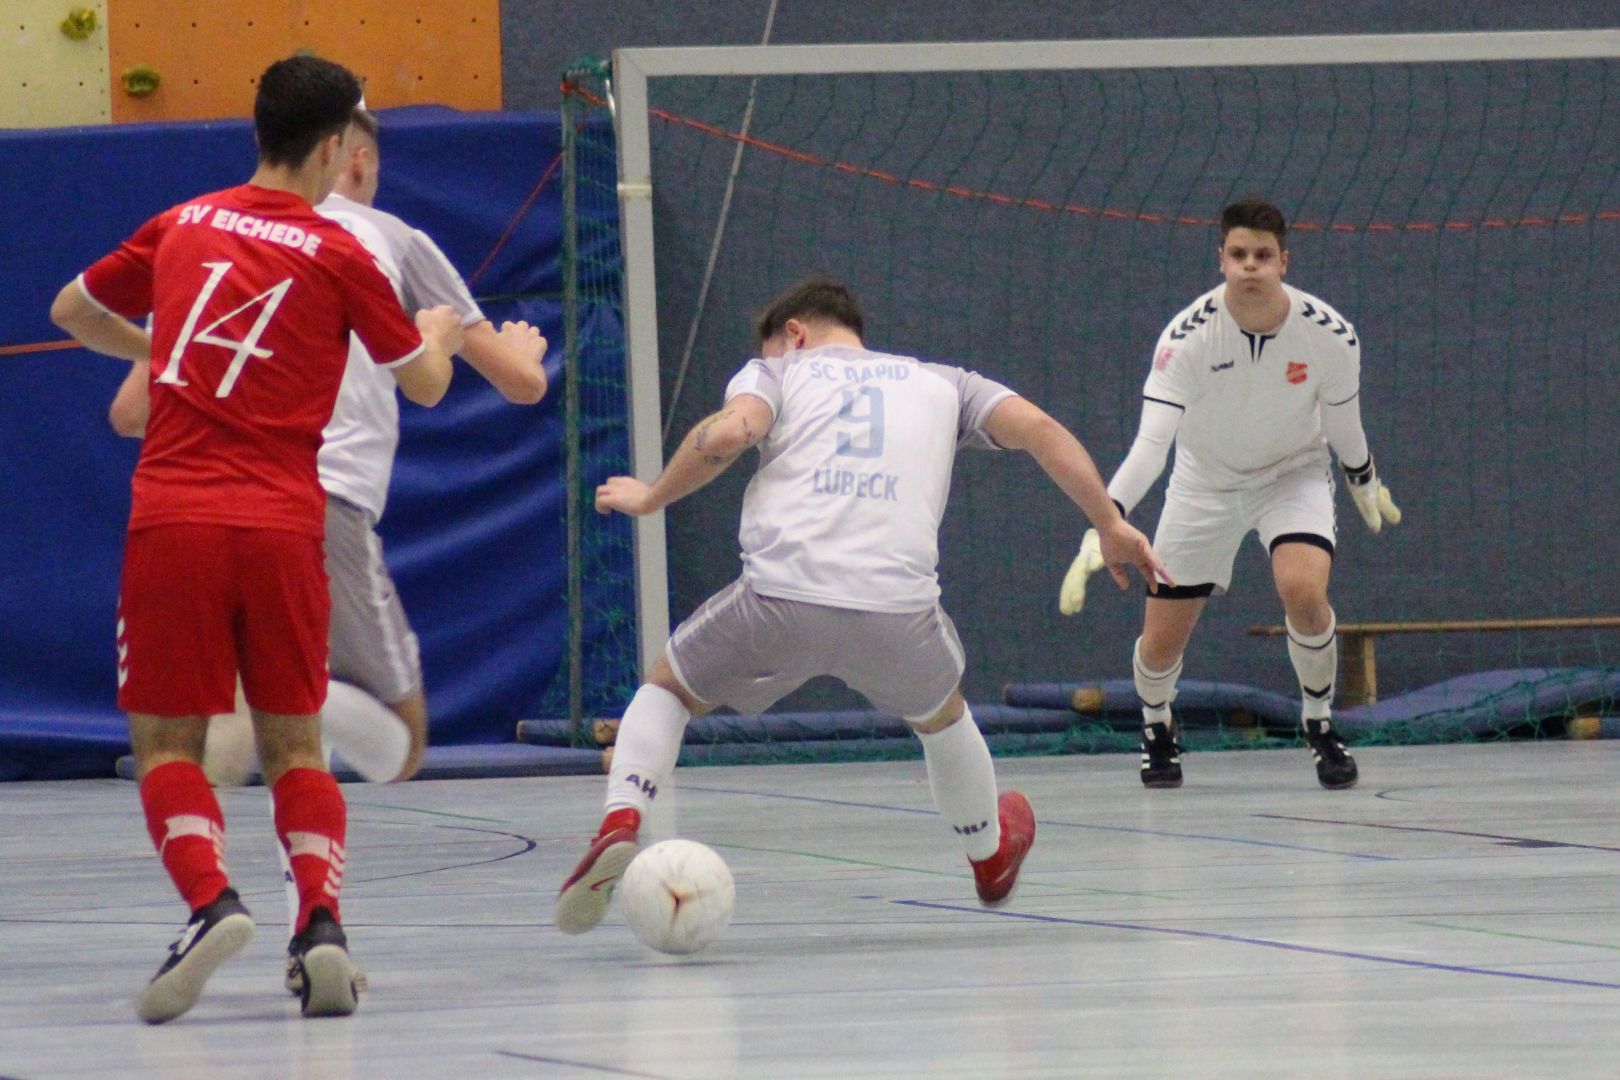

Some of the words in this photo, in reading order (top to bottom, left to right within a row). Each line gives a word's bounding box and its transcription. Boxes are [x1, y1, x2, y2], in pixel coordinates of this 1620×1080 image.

[177, 204, 212, 225] SV
[210, 209, 322, 257] EICHEDE
[154, 261, 293, 398] 14
[809, 361, 838, 381] SC
[836, 386, 885, 459] 9
[812, 465, 898, 502] LÜBECK
